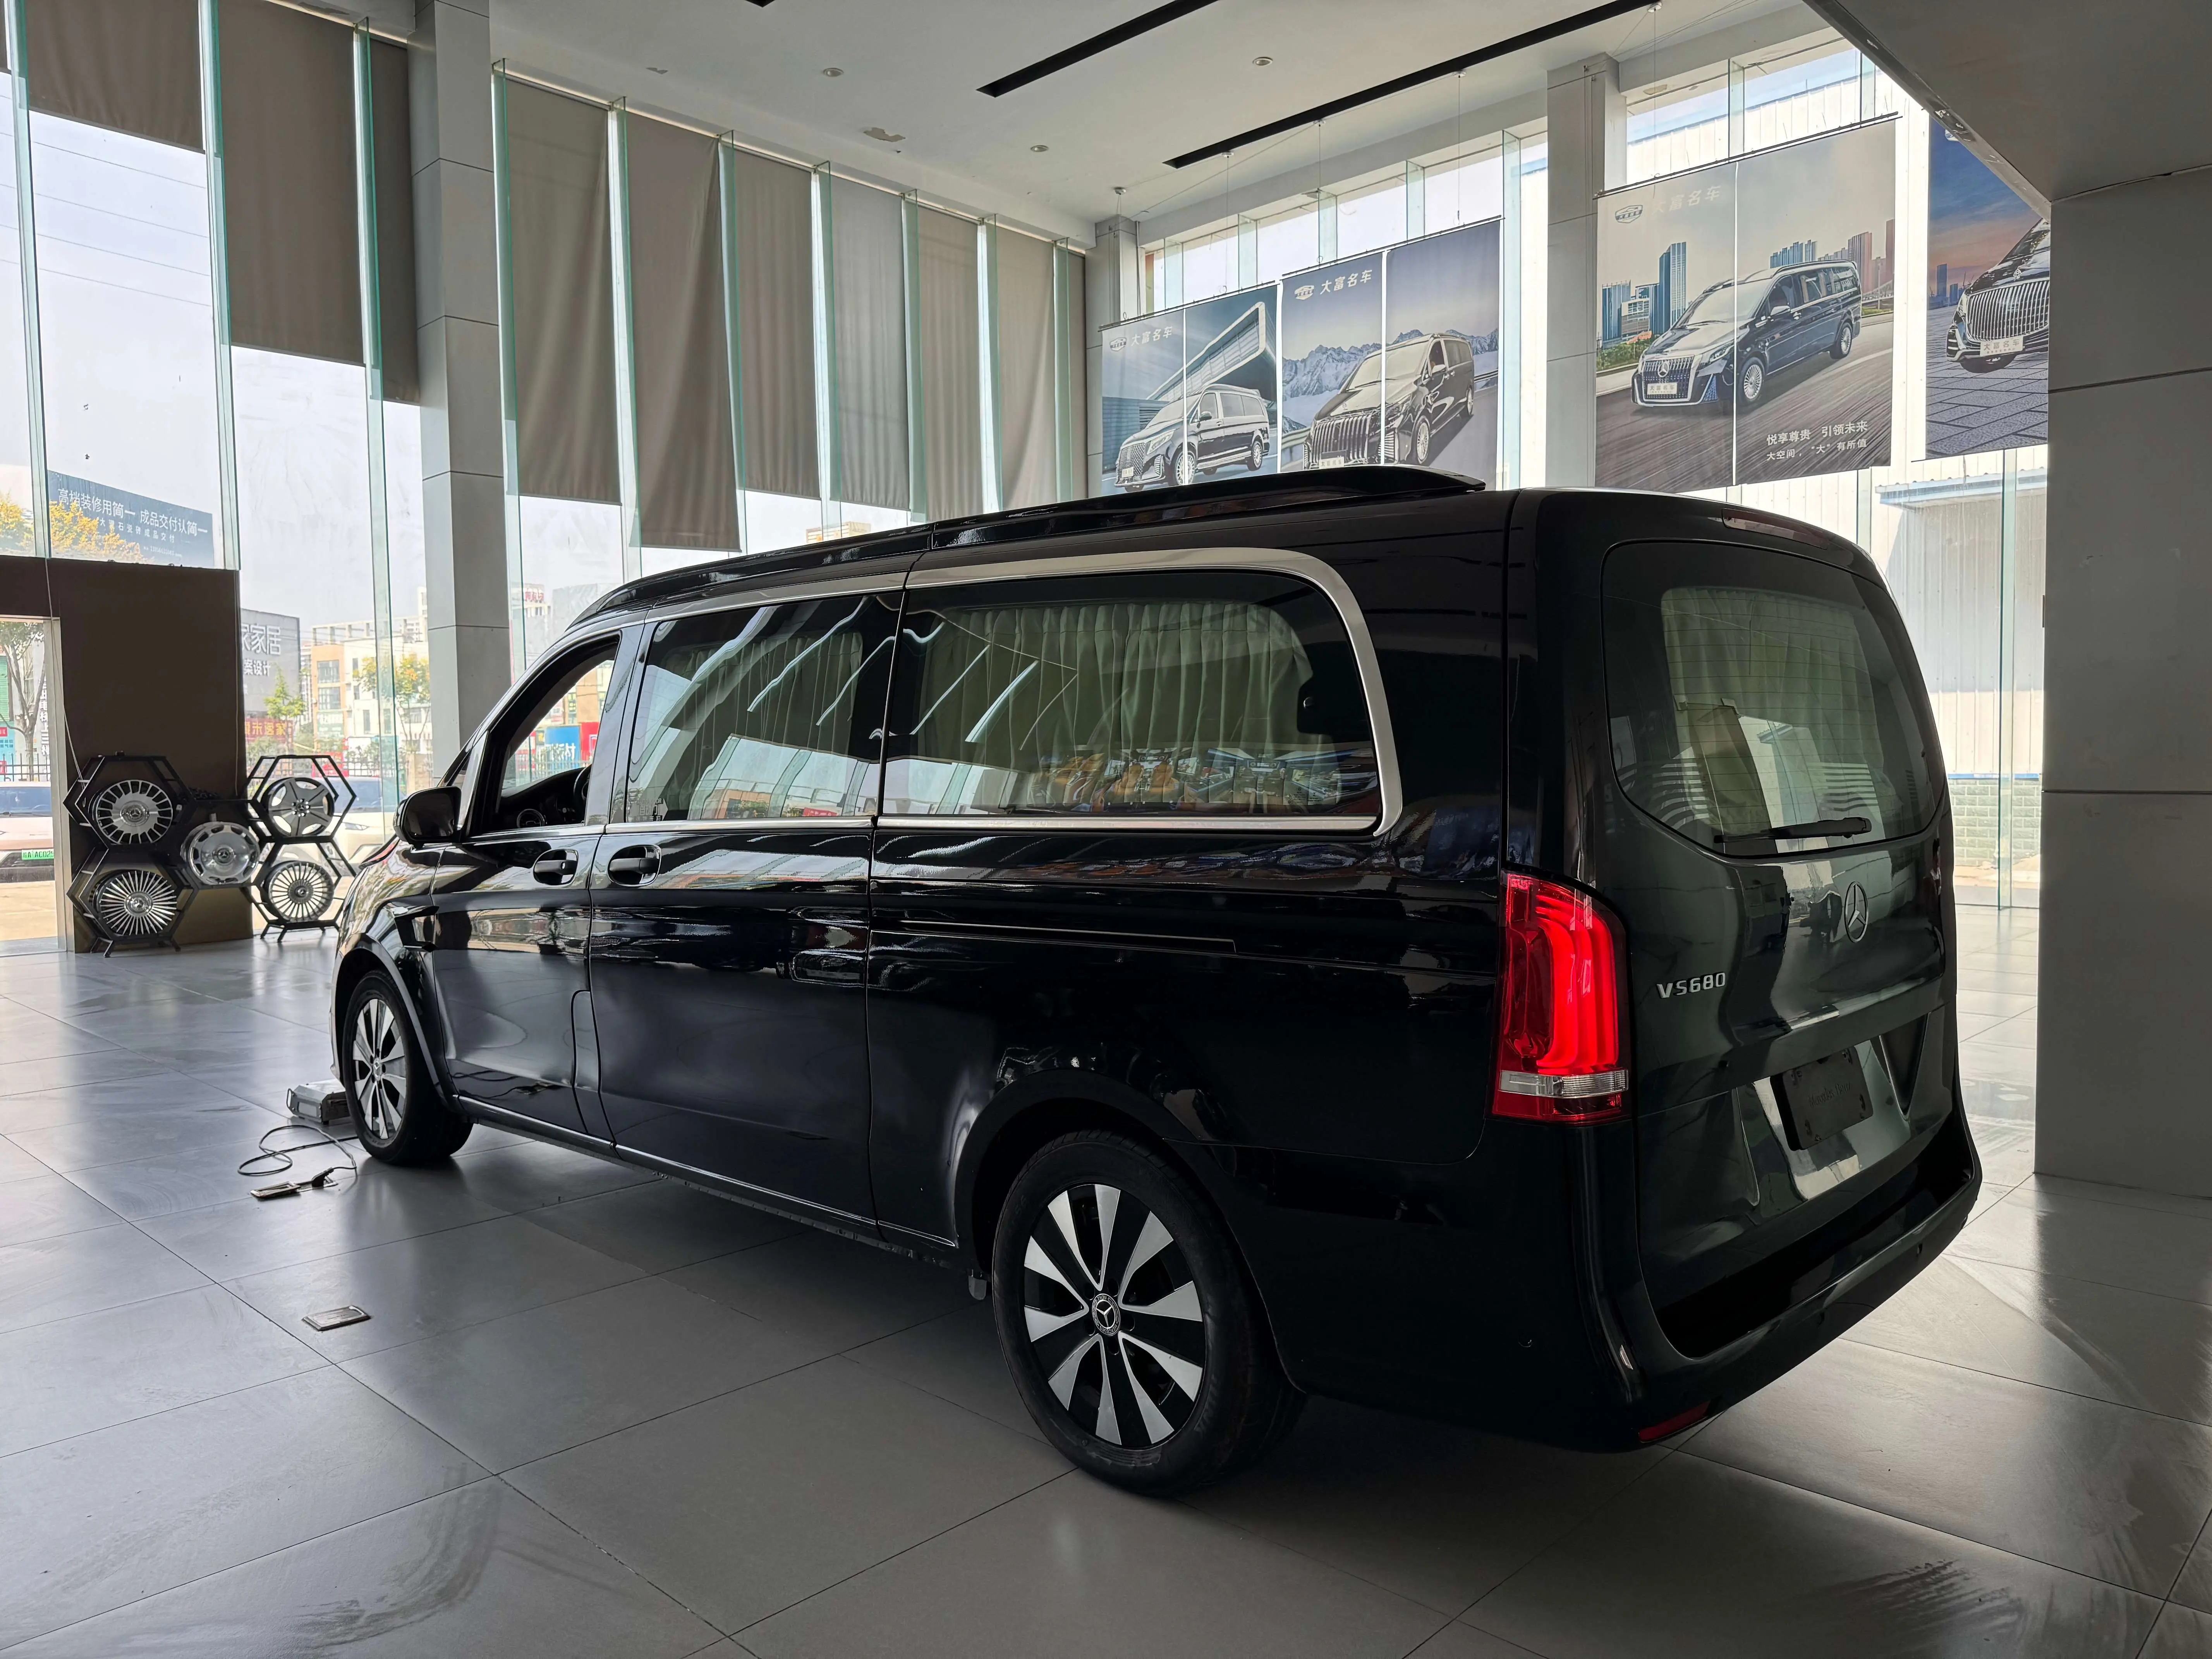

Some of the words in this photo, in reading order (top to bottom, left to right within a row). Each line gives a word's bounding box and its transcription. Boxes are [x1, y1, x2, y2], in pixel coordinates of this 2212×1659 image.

[1652, 185, 1721, 213] 大富名车
[1320, 270, 1372, 295] 大富名车
[1131, 326, 1173, 346] 大富名车
[1766, 429, 1811, 446] 悦享尊贵
[1821, 420, 1868, 438] 引领未来
[58, 488, 136, 519] 高档装修用简一
[140, 509, 208, 537] 成品交付认简一
[1656, 972, 1726, 998] VS680
